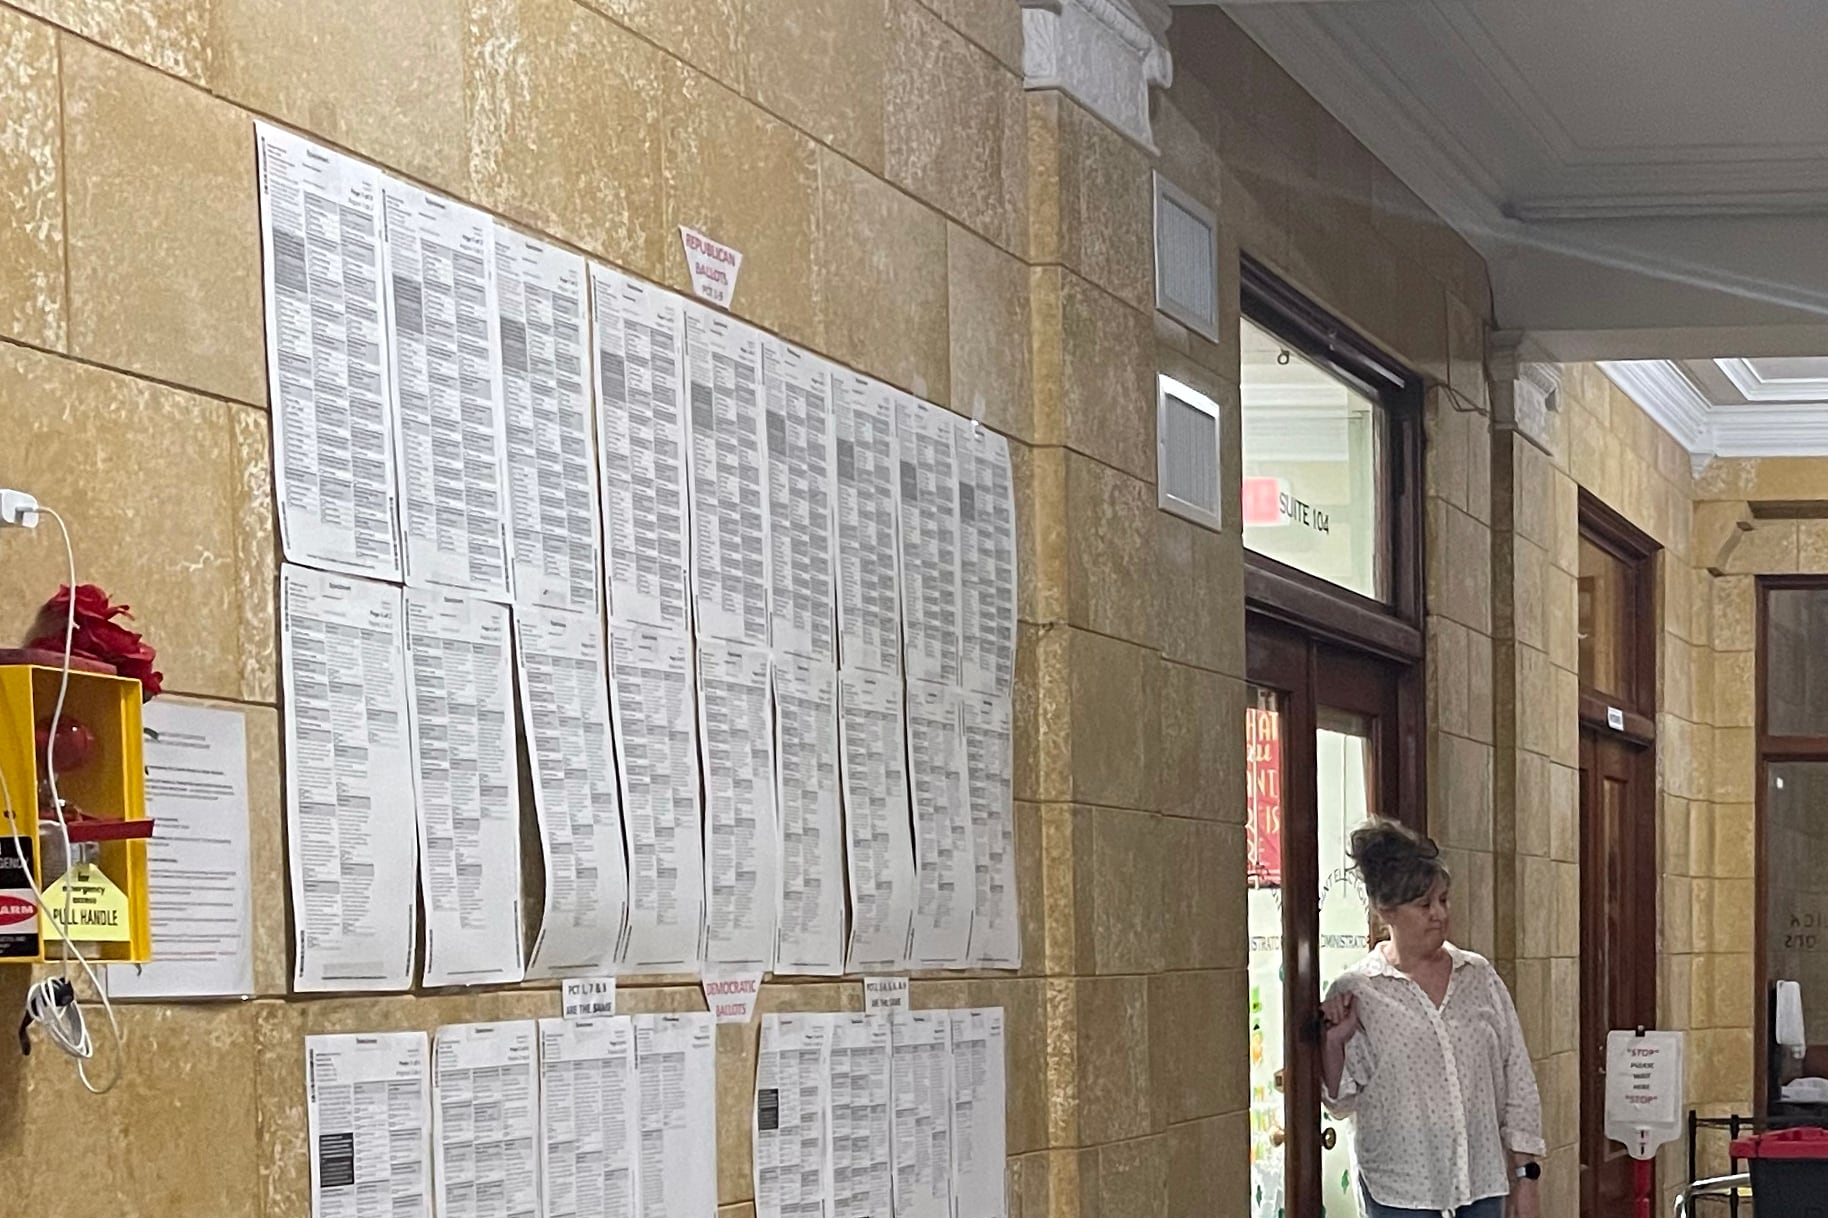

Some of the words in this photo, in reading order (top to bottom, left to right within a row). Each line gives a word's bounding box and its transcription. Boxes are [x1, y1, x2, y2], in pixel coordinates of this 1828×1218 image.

[686, 233, 735, 267] REPUBLICAN
[695, 262, 728, 286] BALLOTS
[1280, 492, 1310, 527] SUITE
[1313, 509, 1329, 535] 104
[80, 910, 118, 926] HANDLE
[707, 980, 755, 995] DEMOCRATIC
[716, 1003, 746, 1017] BALLOTS
